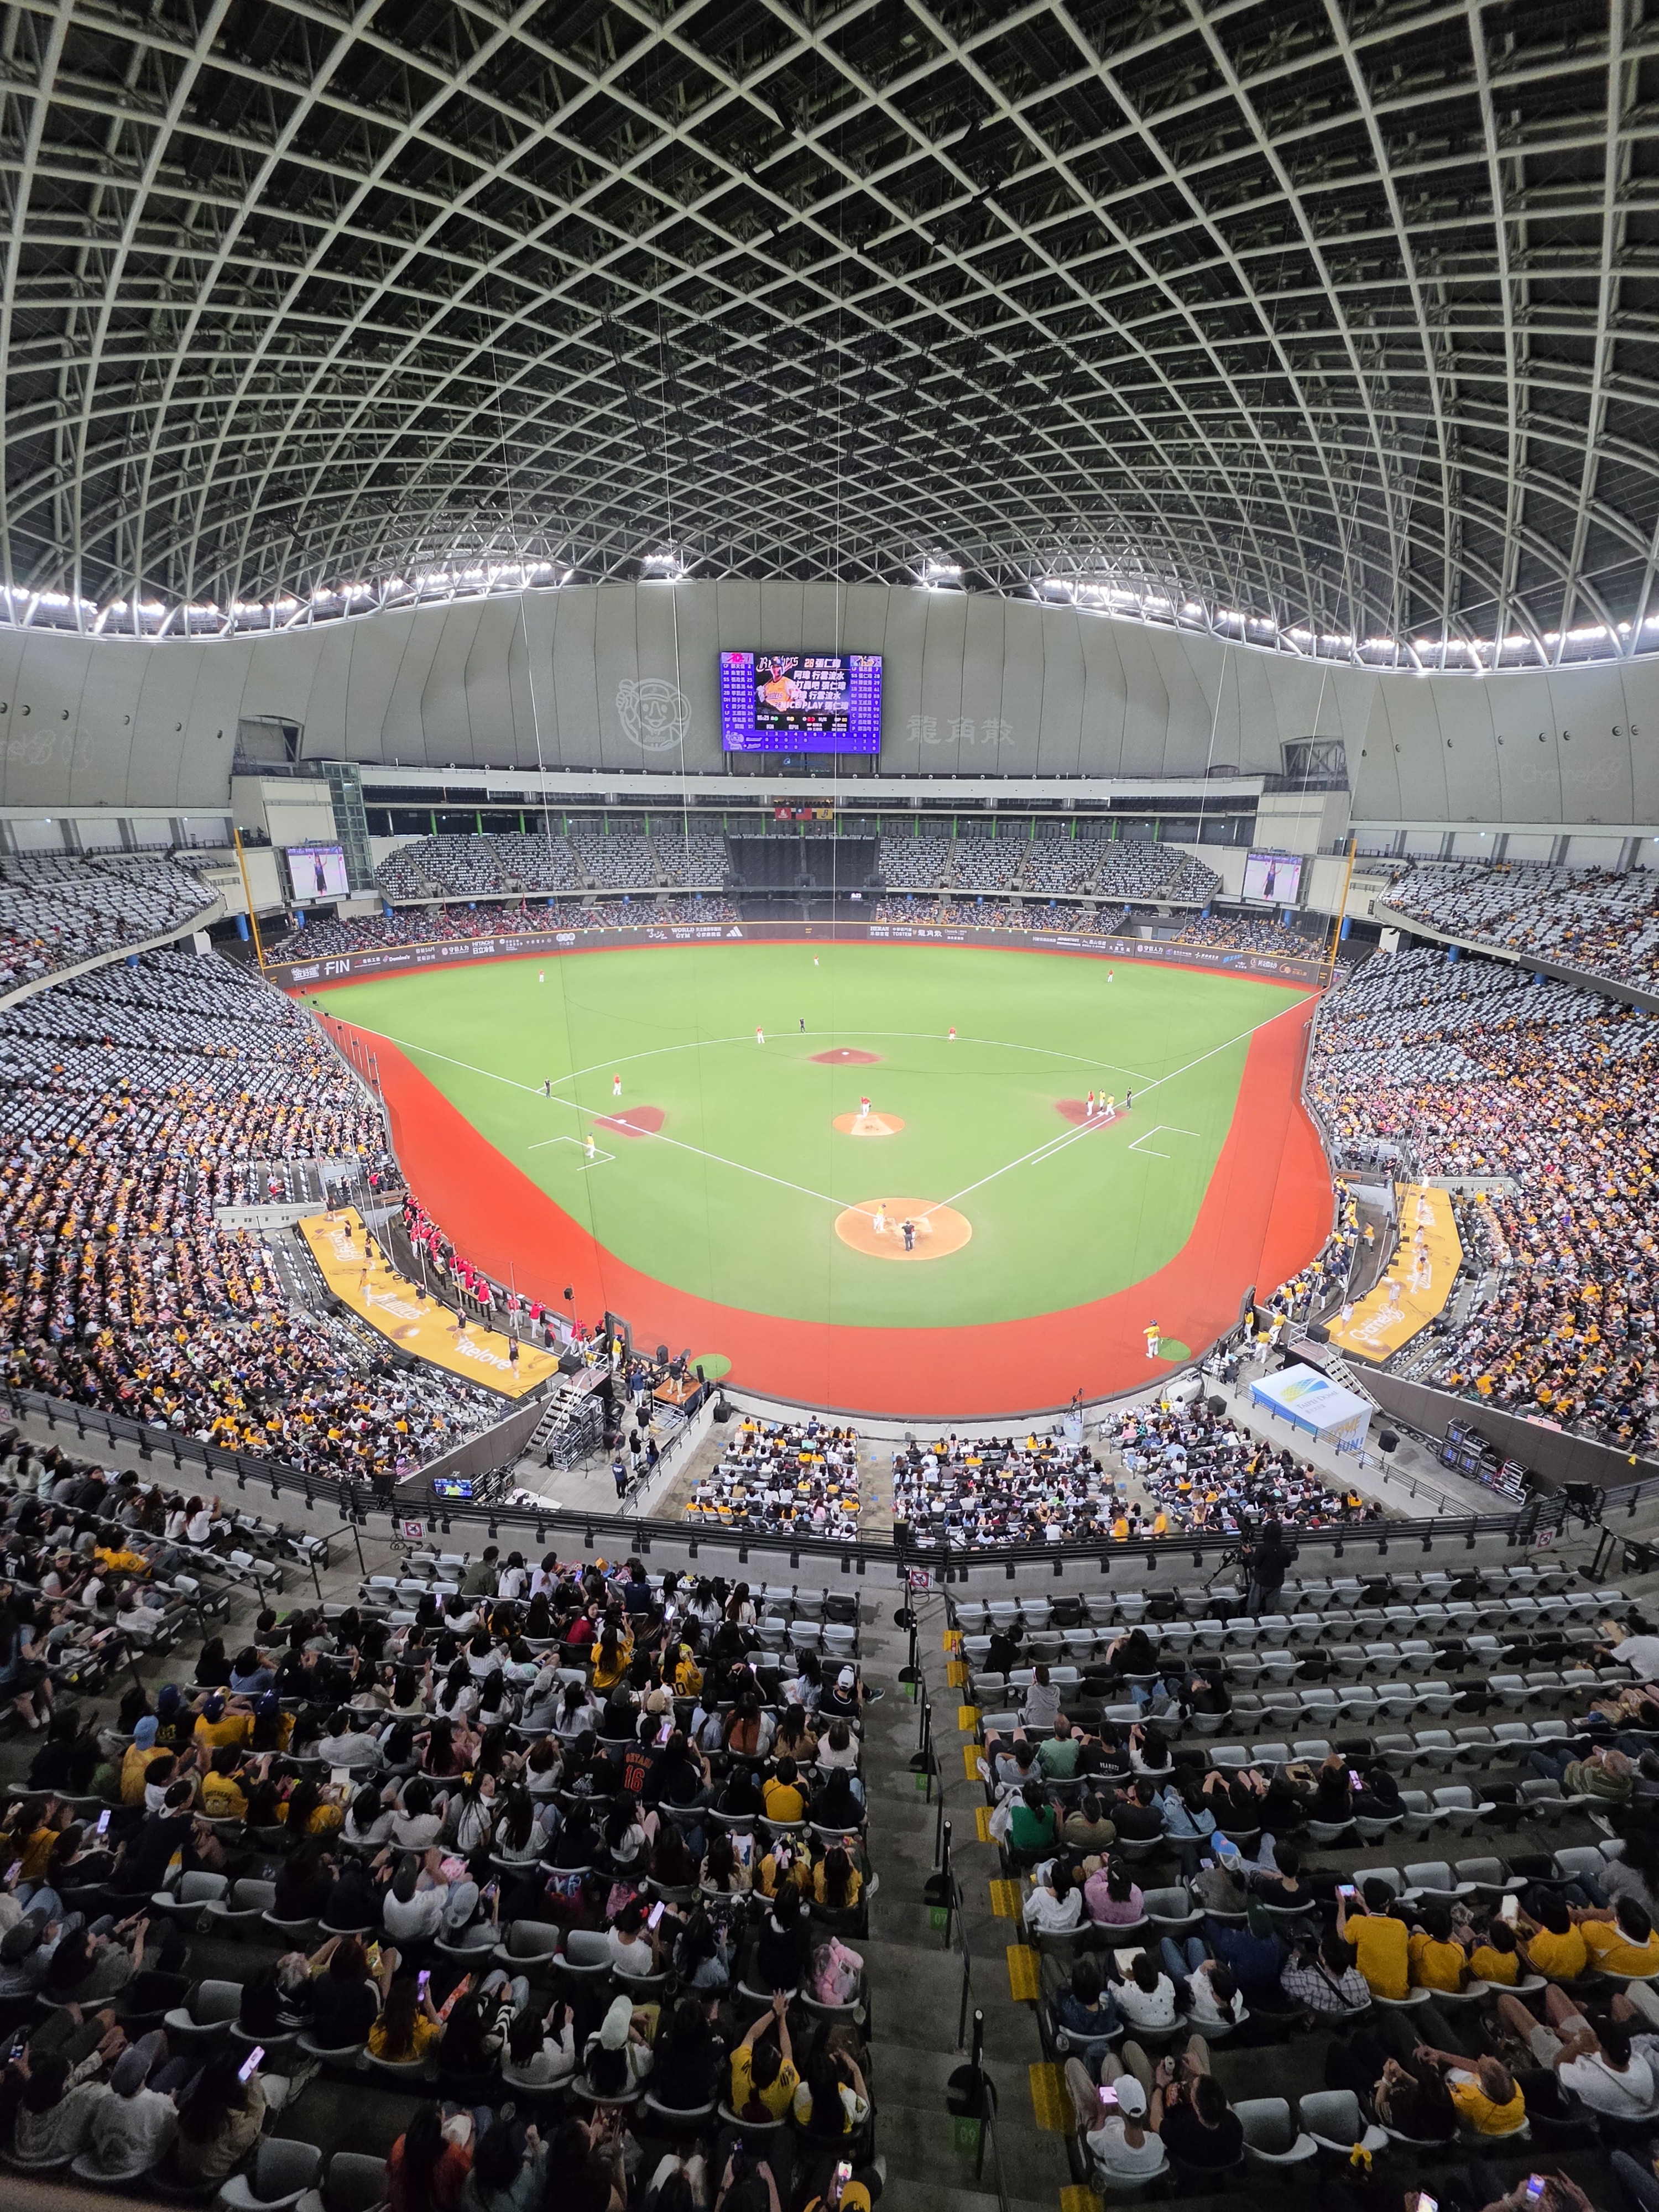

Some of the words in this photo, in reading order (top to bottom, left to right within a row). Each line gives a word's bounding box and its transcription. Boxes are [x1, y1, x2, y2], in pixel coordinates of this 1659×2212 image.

[804, 658, 815, 667] 28
[906, 715, 1015, 745] 龍角散
[918, 929, 942, 937] 龍角散
[324, 959, 349, 975] FIN
[455, 1340, 512, 1370] Relove
[1296, 1400, 1318, 1410] TAIPEI
[1317, 1390, 1339, 1401] DOME
[1100, 1762, 1119, 1771] PEANUTS
[624, 1765, 645, 1792] 16
